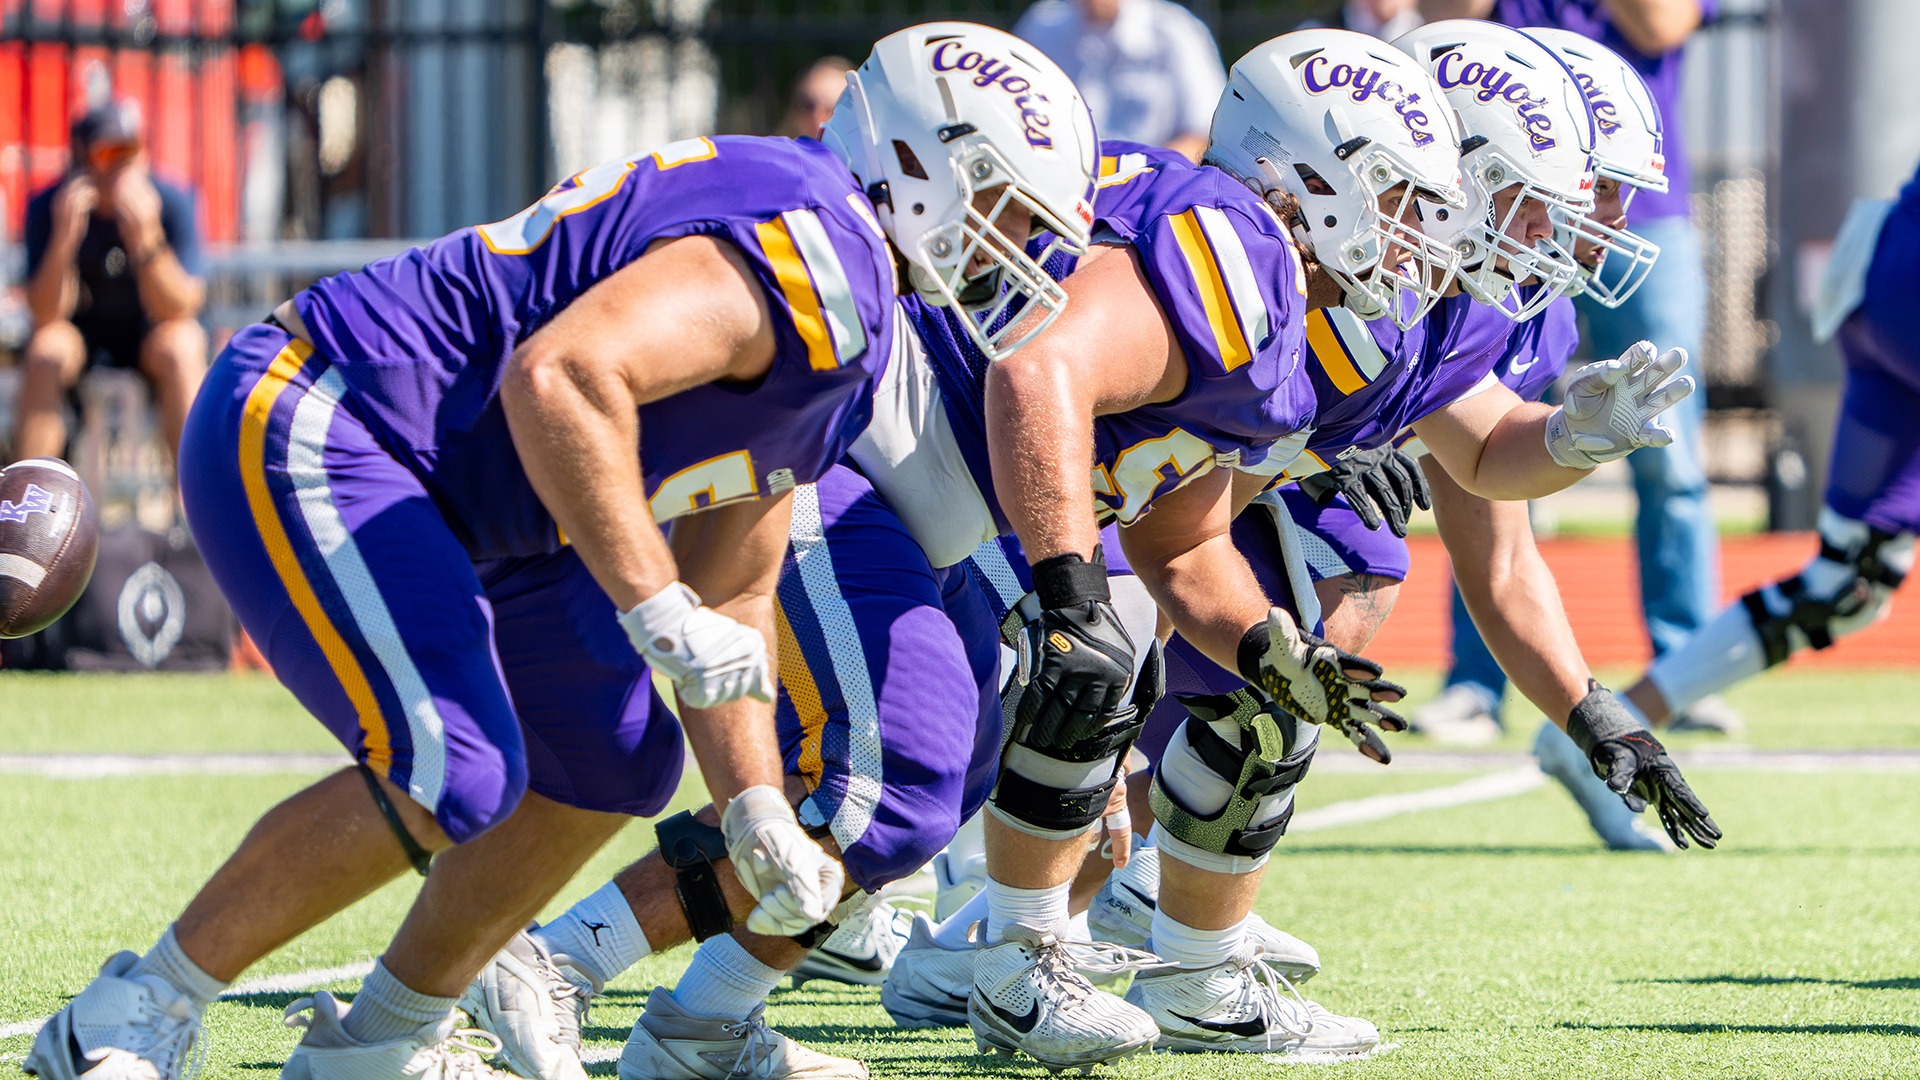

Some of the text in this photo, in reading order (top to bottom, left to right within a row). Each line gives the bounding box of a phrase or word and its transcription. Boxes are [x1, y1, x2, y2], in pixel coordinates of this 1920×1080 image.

[932, 41, 1053, 150] Coyotes
[1304, 56, 1436, 148] Coyotes
[1437, 52, 1556, 151] Coyotes
[1261, 719, 1276, 757] DONJOY
[1104, 897, 1132, 917] ALPHA
